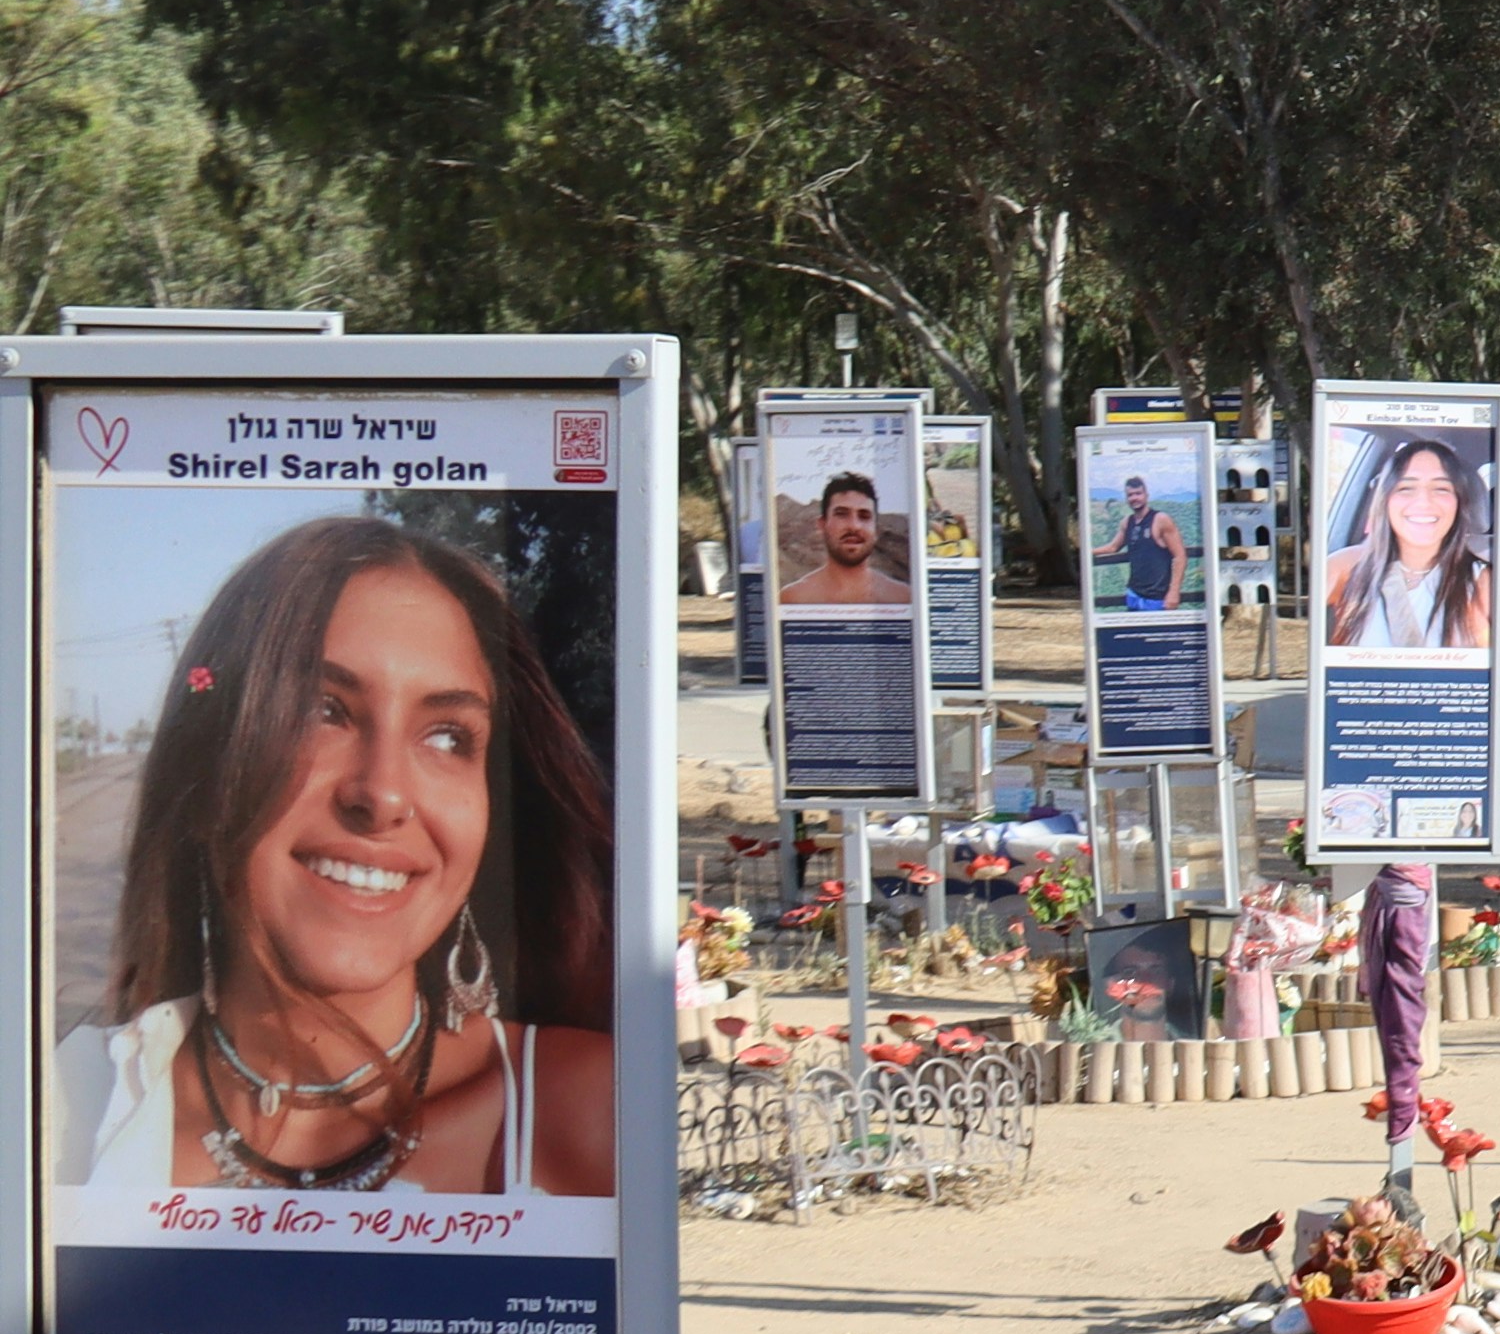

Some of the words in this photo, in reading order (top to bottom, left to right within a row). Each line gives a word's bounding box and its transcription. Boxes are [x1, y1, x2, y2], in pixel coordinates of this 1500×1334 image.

[227, 412, 277, 443] גולן
[286, 417, 343, 440] שרה
[352, 413, 436, 441] שיראל
[1366, 413, 1402, 422] Einbar
[1405, 414, 1436, 423] Shem
[1440, 415, 1459, 424] Tov
[168, 452, 267, 479] Shirel
[281, 454, 380, 480] Sarah
[393, 455, 488, 487] golan
